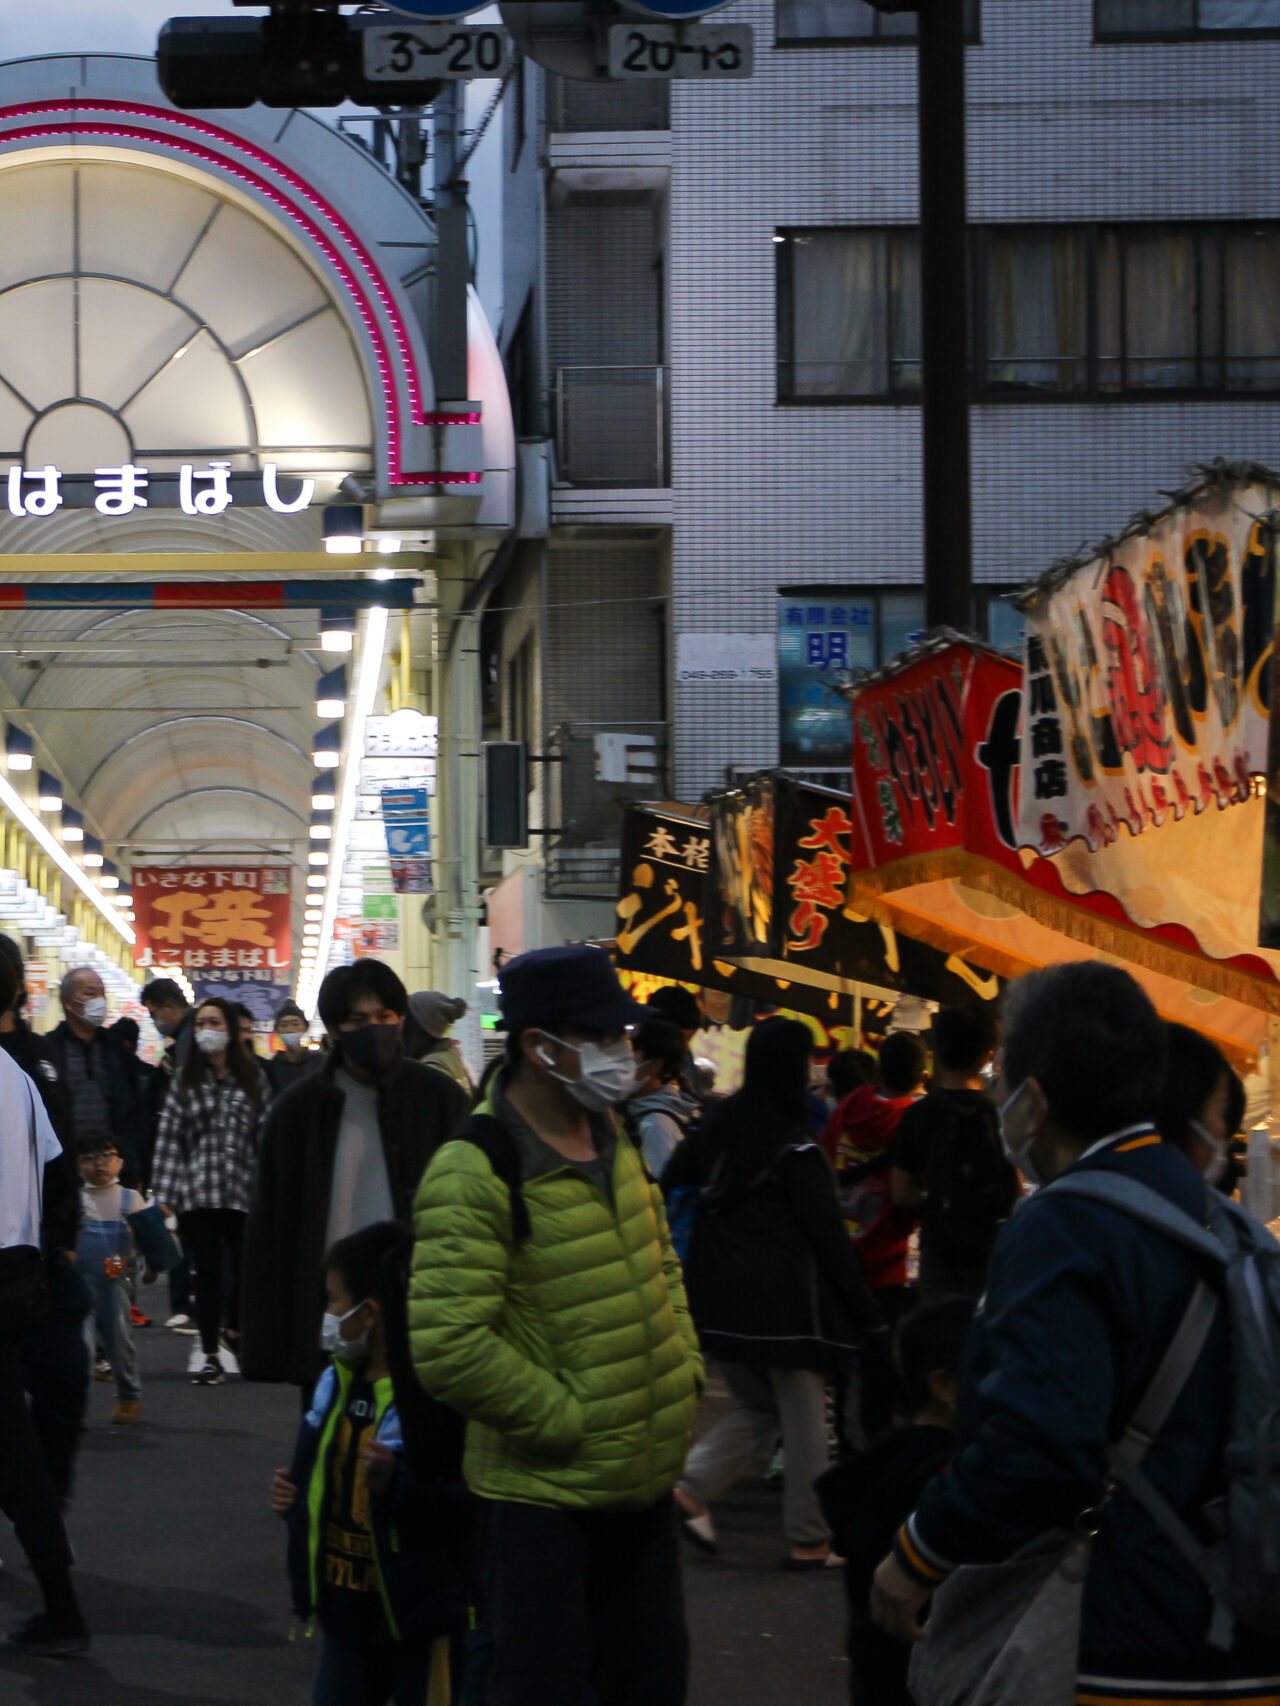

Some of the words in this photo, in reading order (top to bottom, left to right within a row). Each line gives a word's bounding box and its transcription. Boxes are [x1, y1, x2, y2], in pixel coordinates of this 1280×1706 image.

[785, 606, 871, 626] 有限会社
[135, 872, 257, 888] いきな下町
[786, 805, 854, 952] 大盛り
[135, 947, 290, 968] よこはまばし
